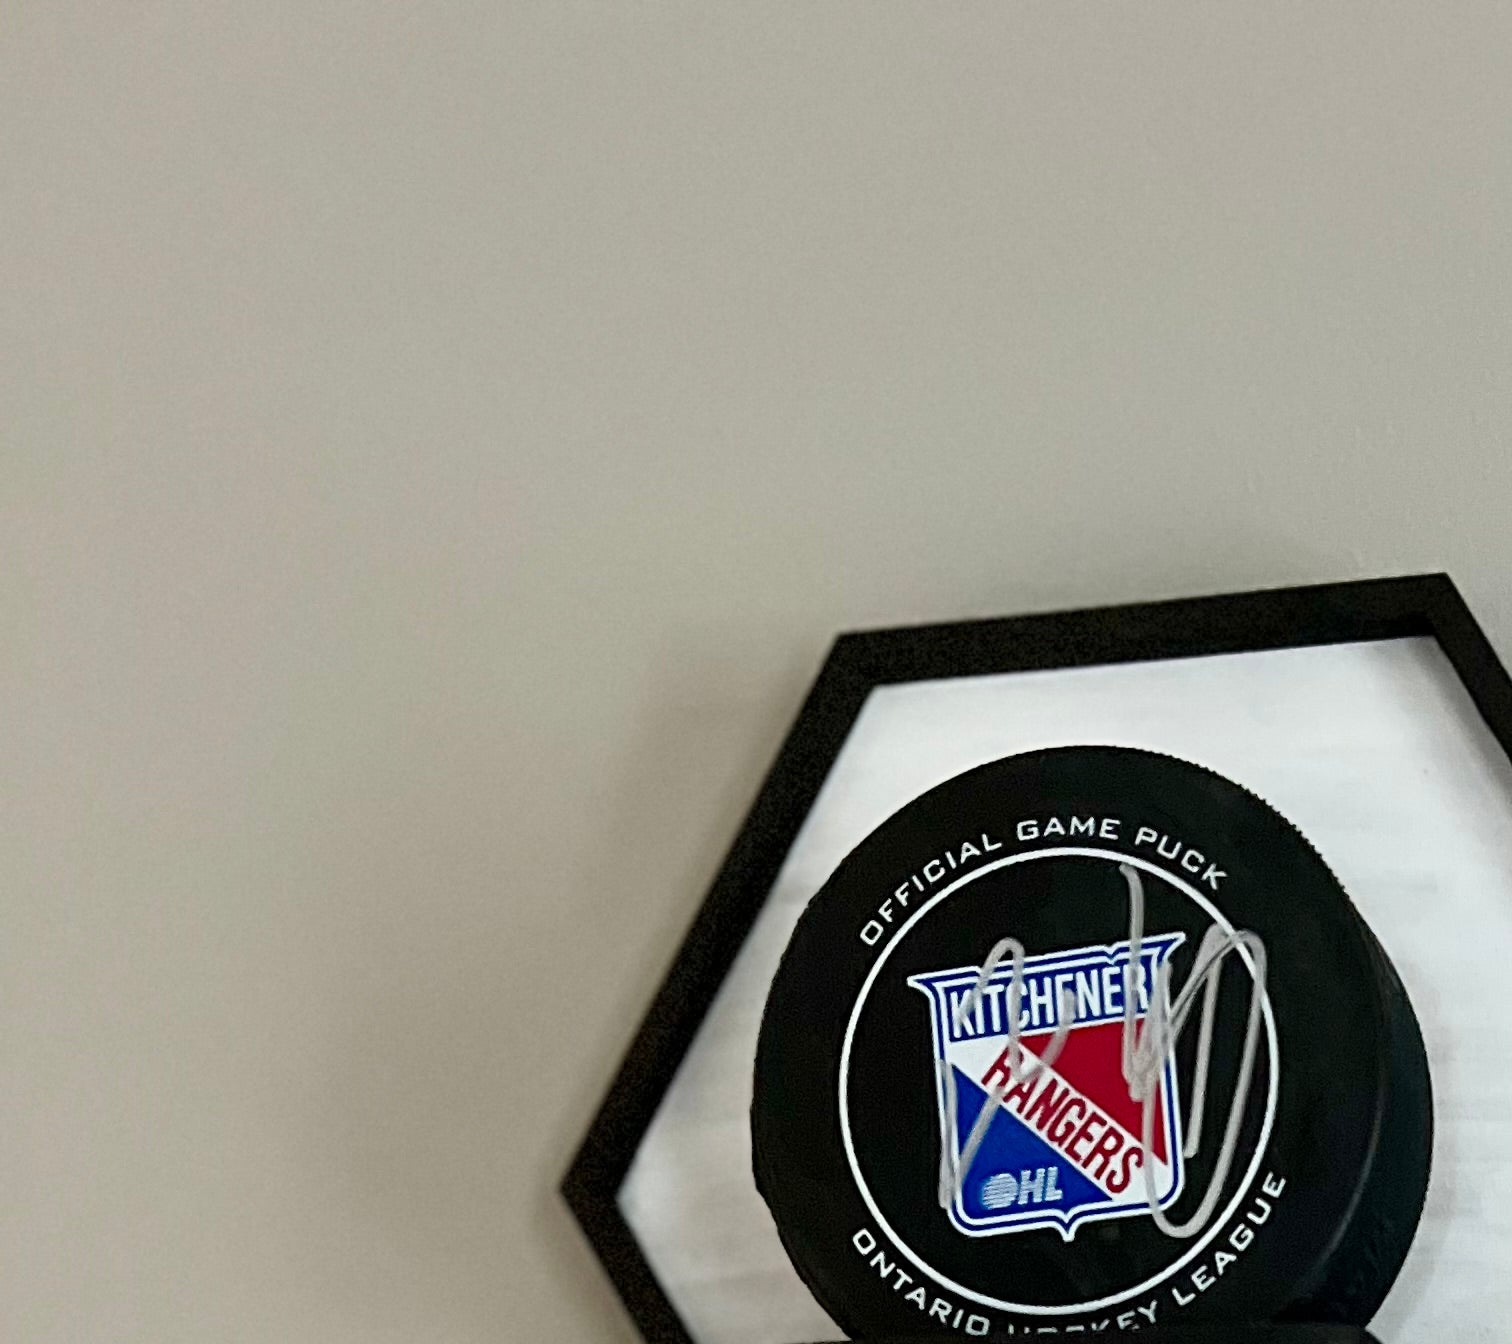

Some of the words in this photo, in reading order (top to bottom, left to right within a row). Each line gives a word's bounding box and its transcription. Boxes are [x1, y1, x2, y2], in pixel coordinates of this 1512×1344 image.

[859, 832, 1002, 946] OFFICIAL
[1016, 816, 1121, 841] GAME
[1135, 826, 1229, 890] PUCK
[981, 1045, 1145, 1194] RANGERS
[982, 1166, 1063, 1210] OHL
[852, 1228, 990, 1337] ONTARIO
[1171, 1170, 1288, 1306] LEAGUE
